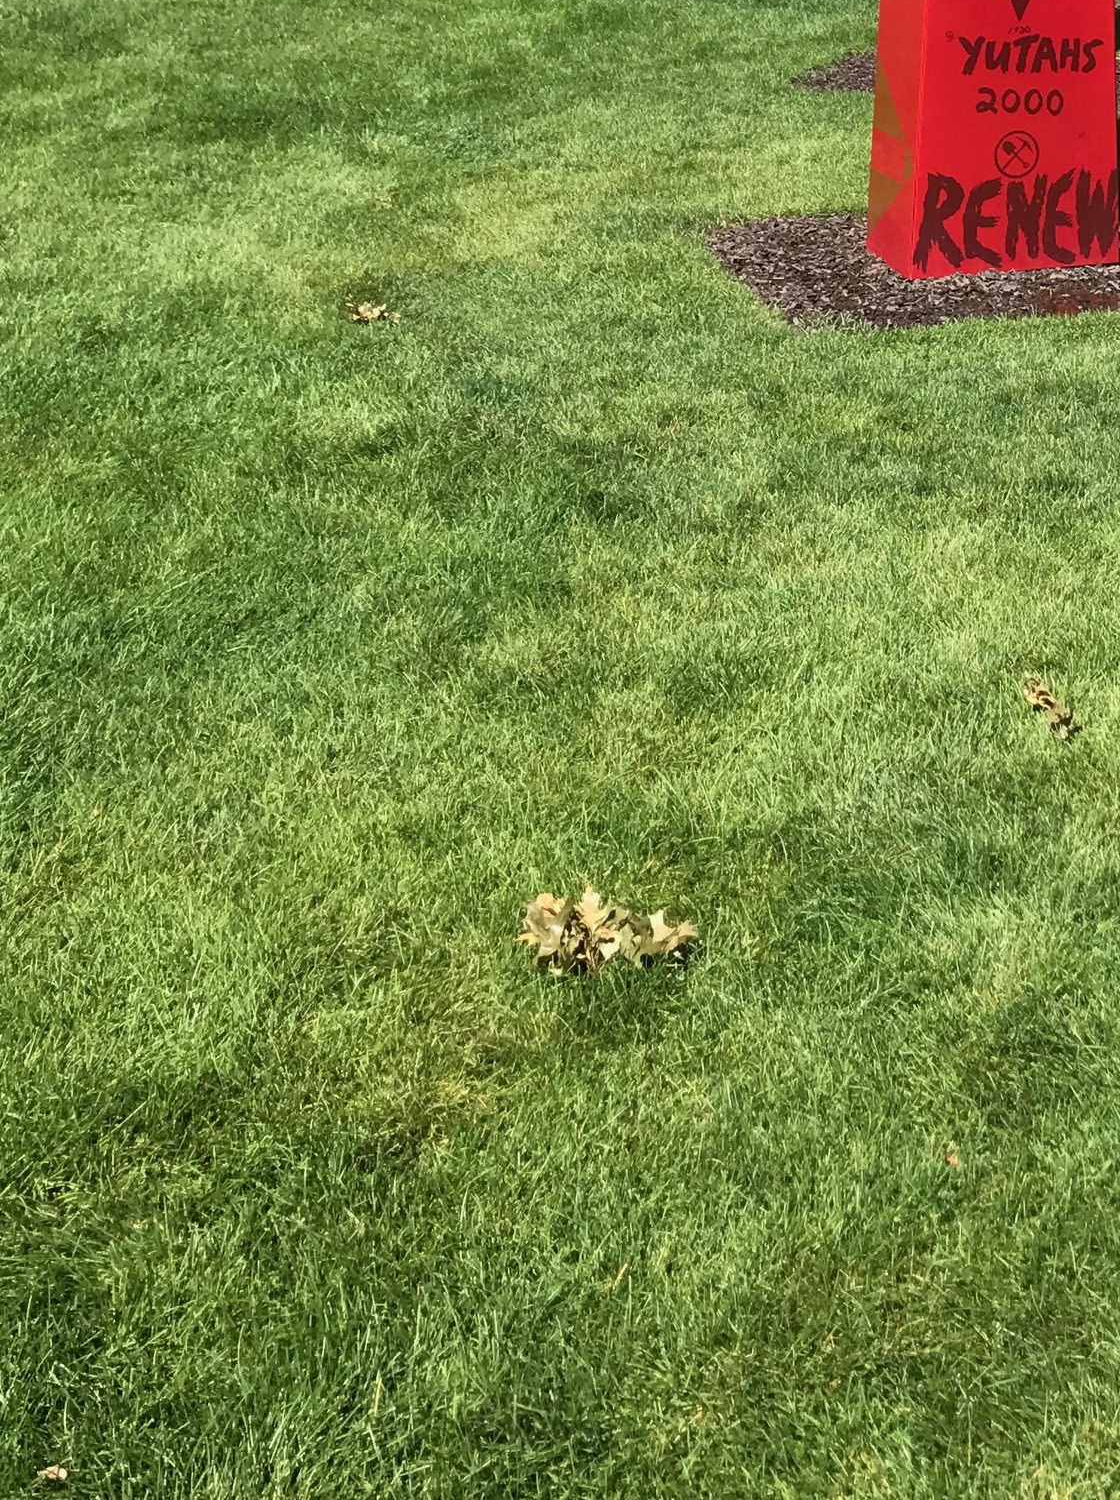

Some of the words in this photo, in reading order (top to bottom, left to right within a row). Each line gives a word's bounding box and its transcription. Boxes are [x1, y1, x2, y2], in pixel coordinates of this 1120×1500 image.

[959, 33, 1104, 76] YUTAHS
[976, 87, 1064, 116] 2000
[913, 168, 1119, 274] RENEW
